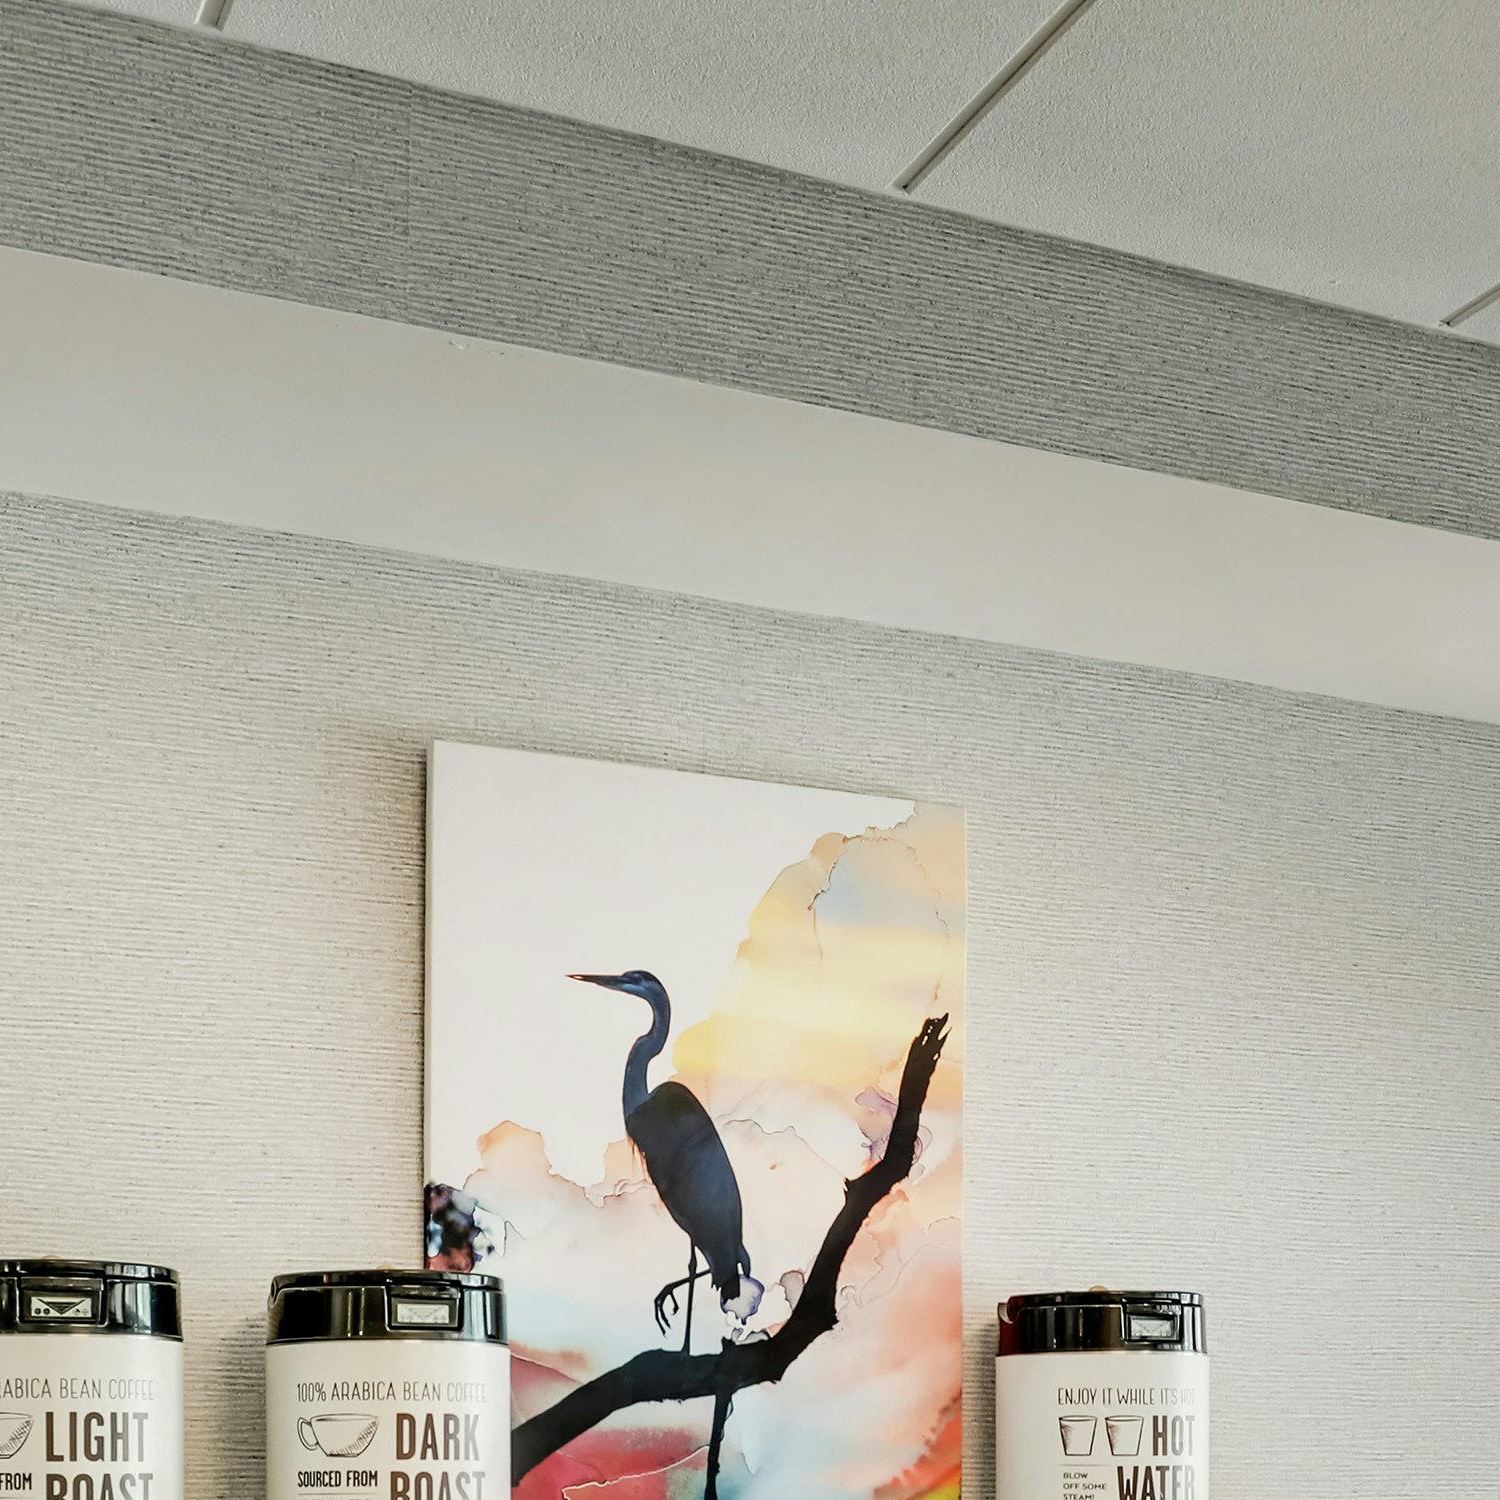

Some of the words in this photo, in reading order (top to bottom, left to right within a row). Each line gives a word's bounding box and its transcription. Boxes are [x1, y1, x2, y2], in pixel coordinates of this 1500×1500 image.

[59, 1378, 102, 1400] BEAN
[108, 1379, 155, 1401] COFFEE
[297, 1382, 327, 1402] 100%
[331, 1381, 397, 1402] ARABICA
[403, 1381, 441, 1401] BEAN
[447, 1382, 487, 1404] COFFEE
[1057, 1387, 1097, 1405] ENJOY
[1102, 1387, 1113, 1405] IT
[1116, 1387, 1156, 1405] WHILE
[45, 1411, 149, 1462] LIGHT
[396, 1412, 480, 1461] DARK
[1152, 1415, 1196, 1456] HOT
[297, 1470, 342, 1488] SOURCED
[347, 1470, 379, 1488] FROM
[1063, 1472, 1089, 1480] BLOW
[1062, 1493, 1095, 1500] STEAM!
